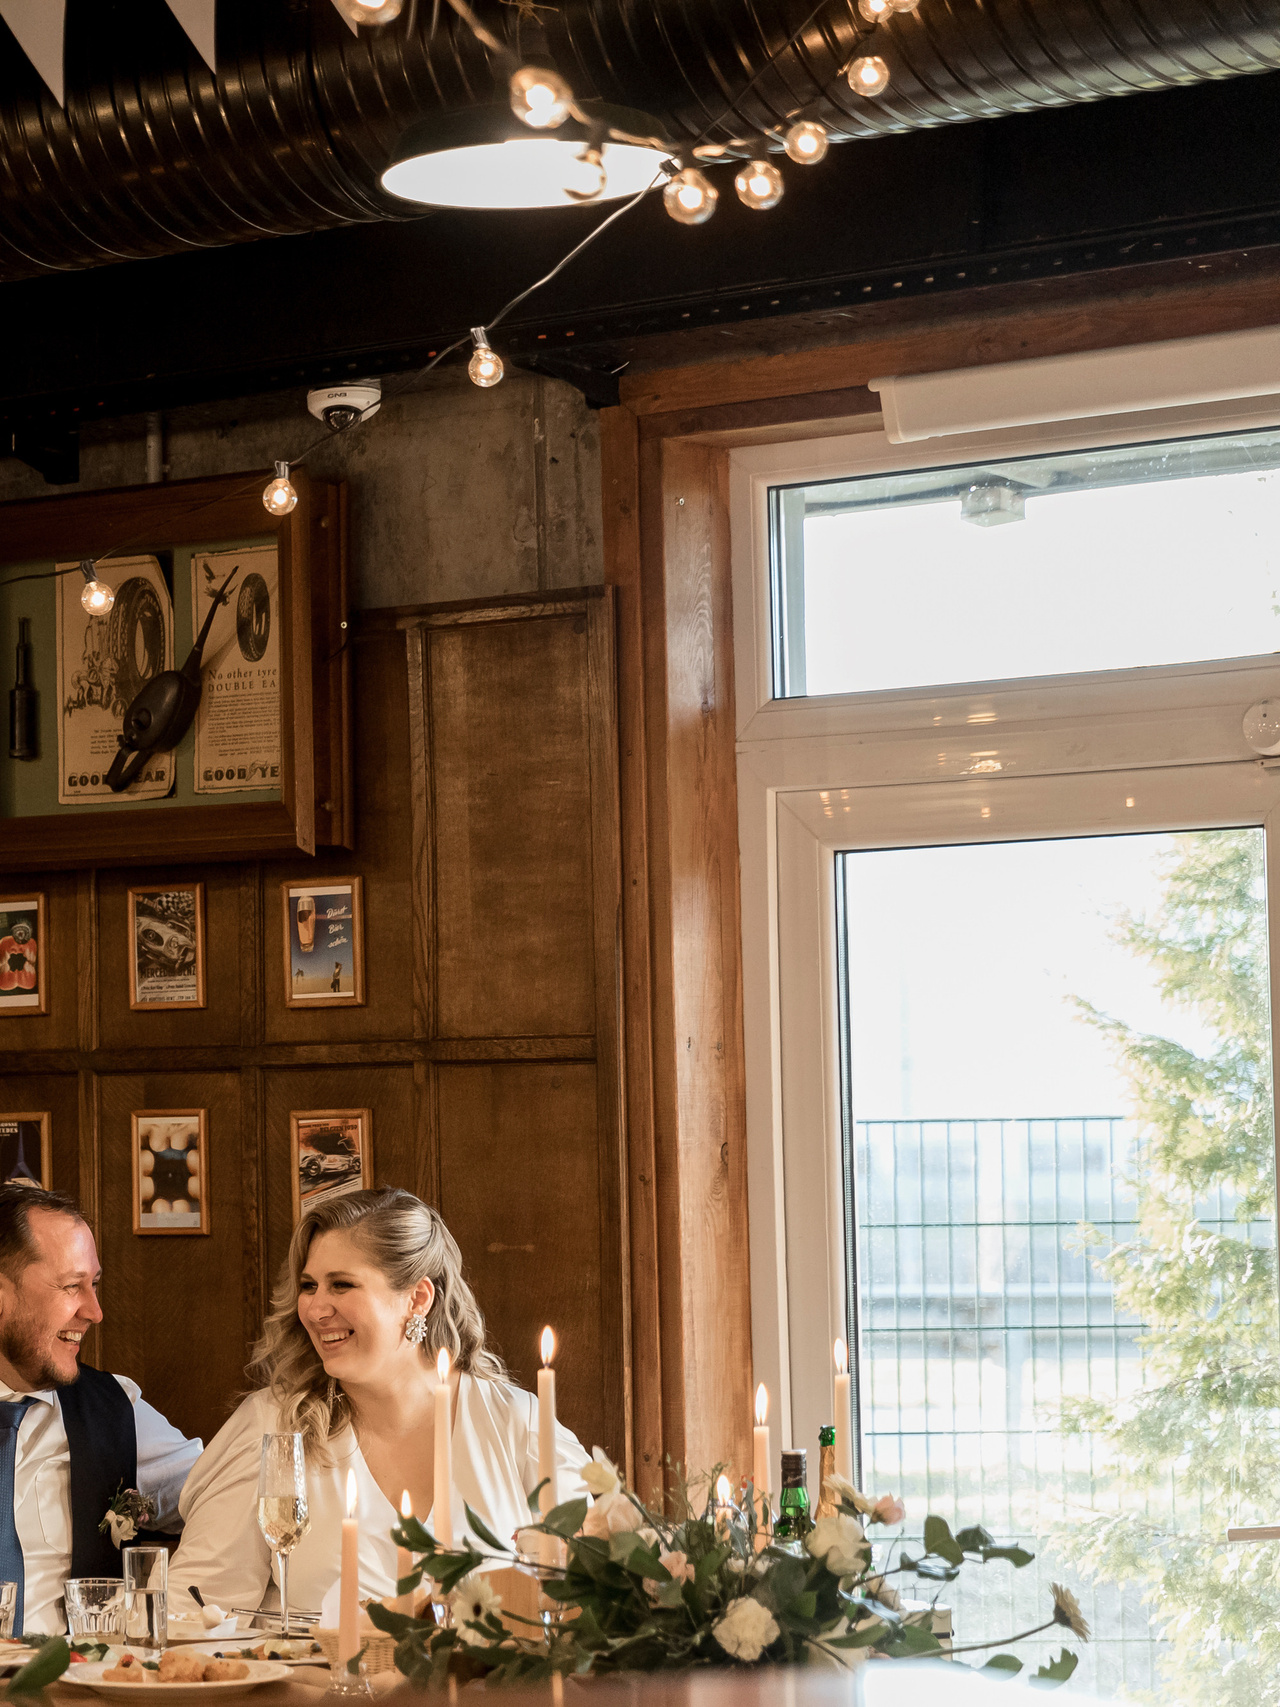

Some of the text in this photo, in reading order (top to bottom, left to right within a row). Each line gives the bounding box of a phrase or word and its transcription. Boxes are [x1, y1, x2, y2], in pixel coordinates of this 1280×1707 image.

[208, 668, 277, 681] No other tyre
[208, 681, 255, 693] DOUBLE
